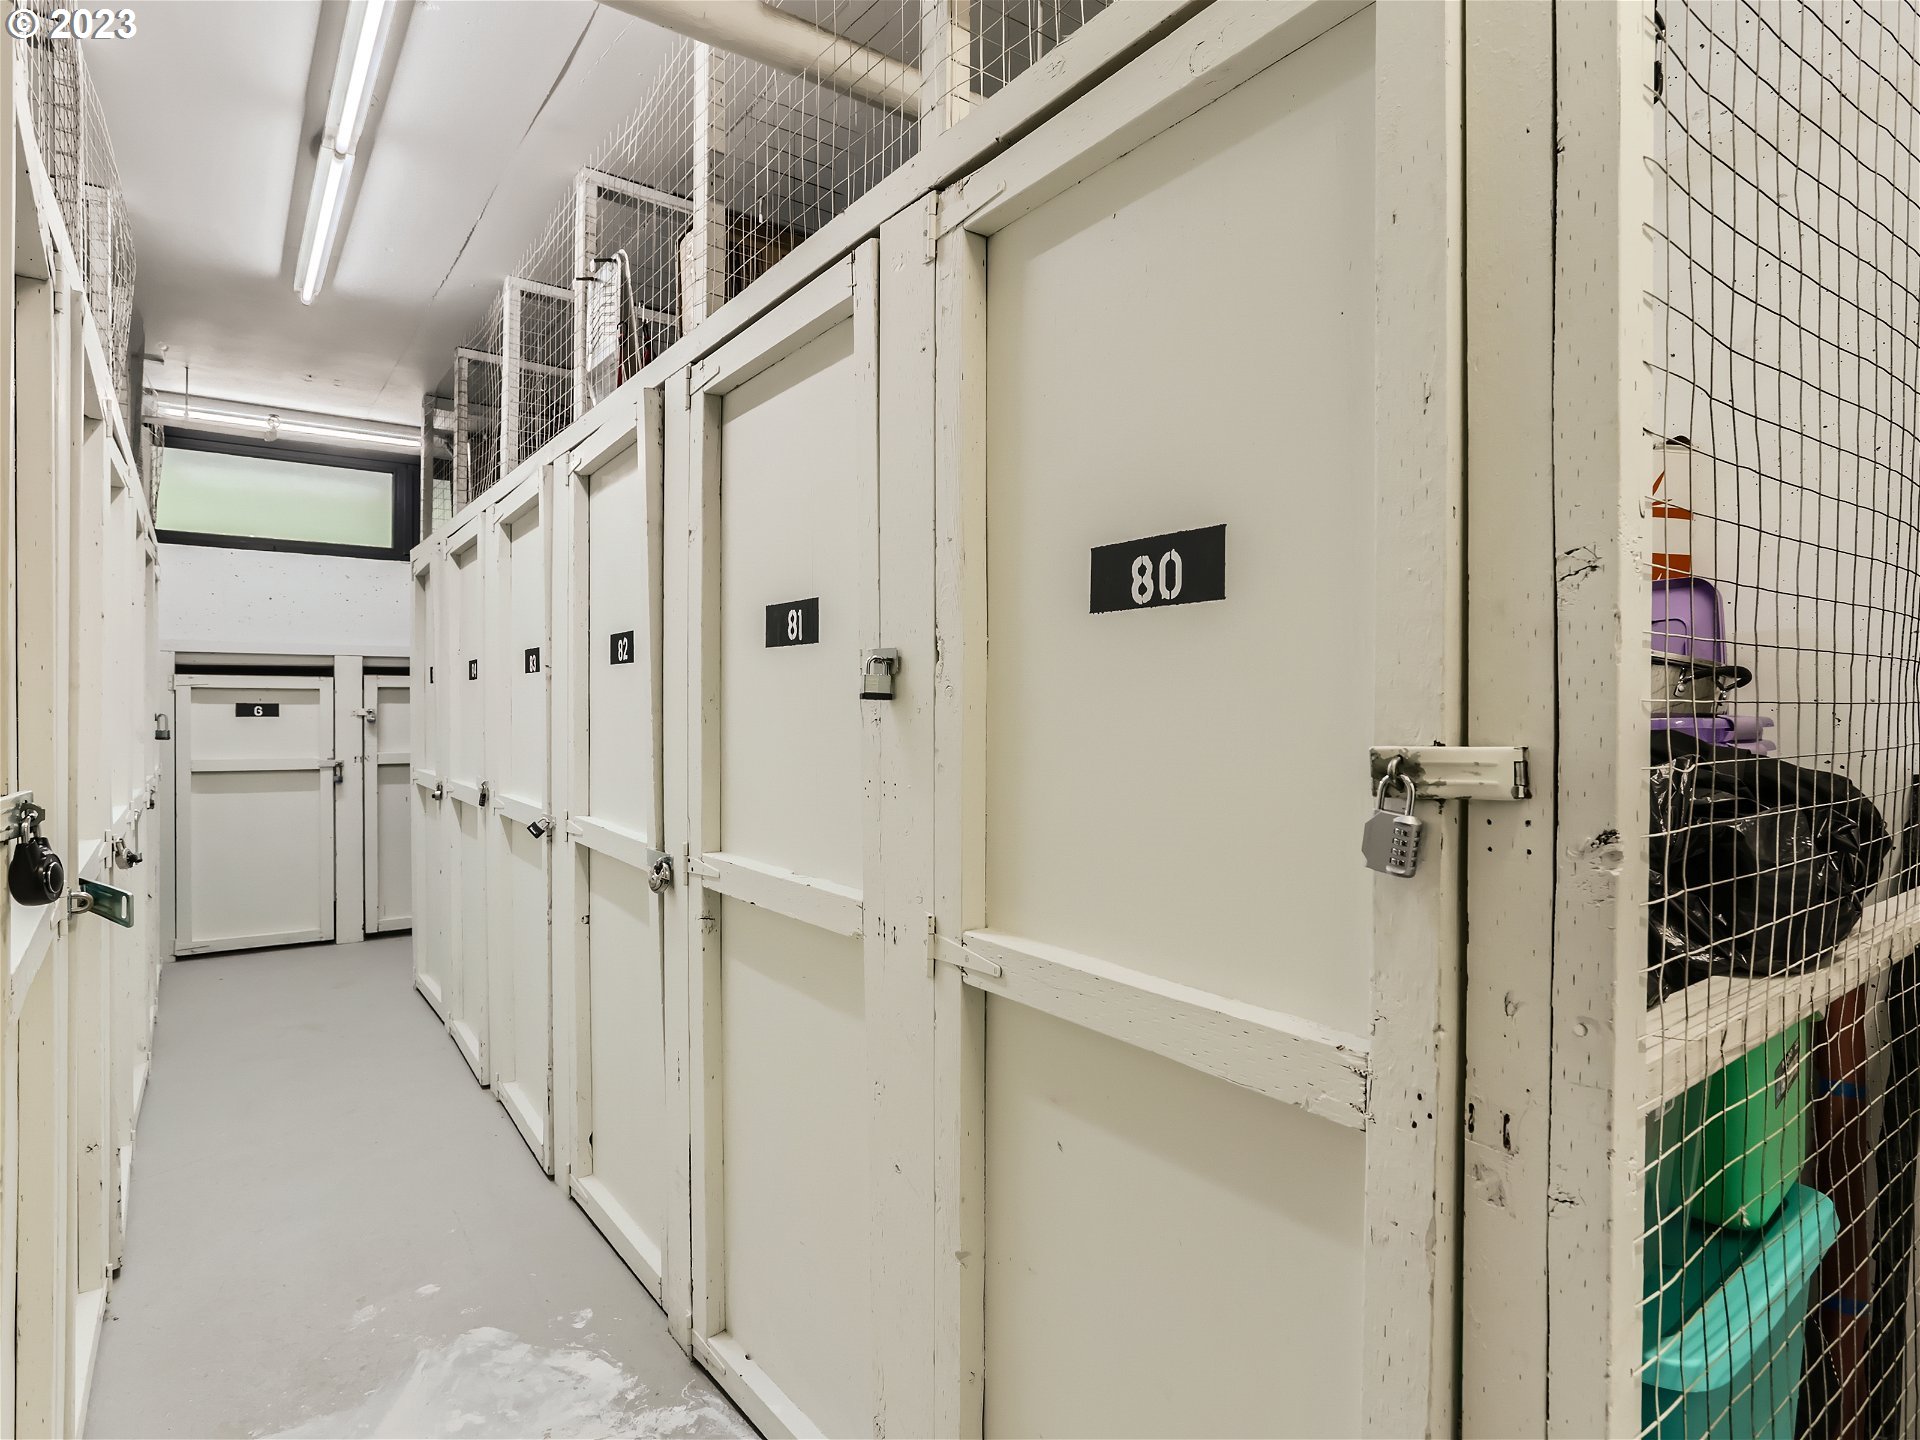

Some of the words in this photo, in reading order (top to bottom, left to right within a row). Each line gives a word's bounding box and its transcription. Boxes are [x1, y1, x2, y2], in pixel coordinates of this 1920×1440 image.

[1131, 549, 1183, 605] 80
[787, 609, 803, 641] 81
[617, 636, 628, 662] 82
[254, 705, 263, 716] G
